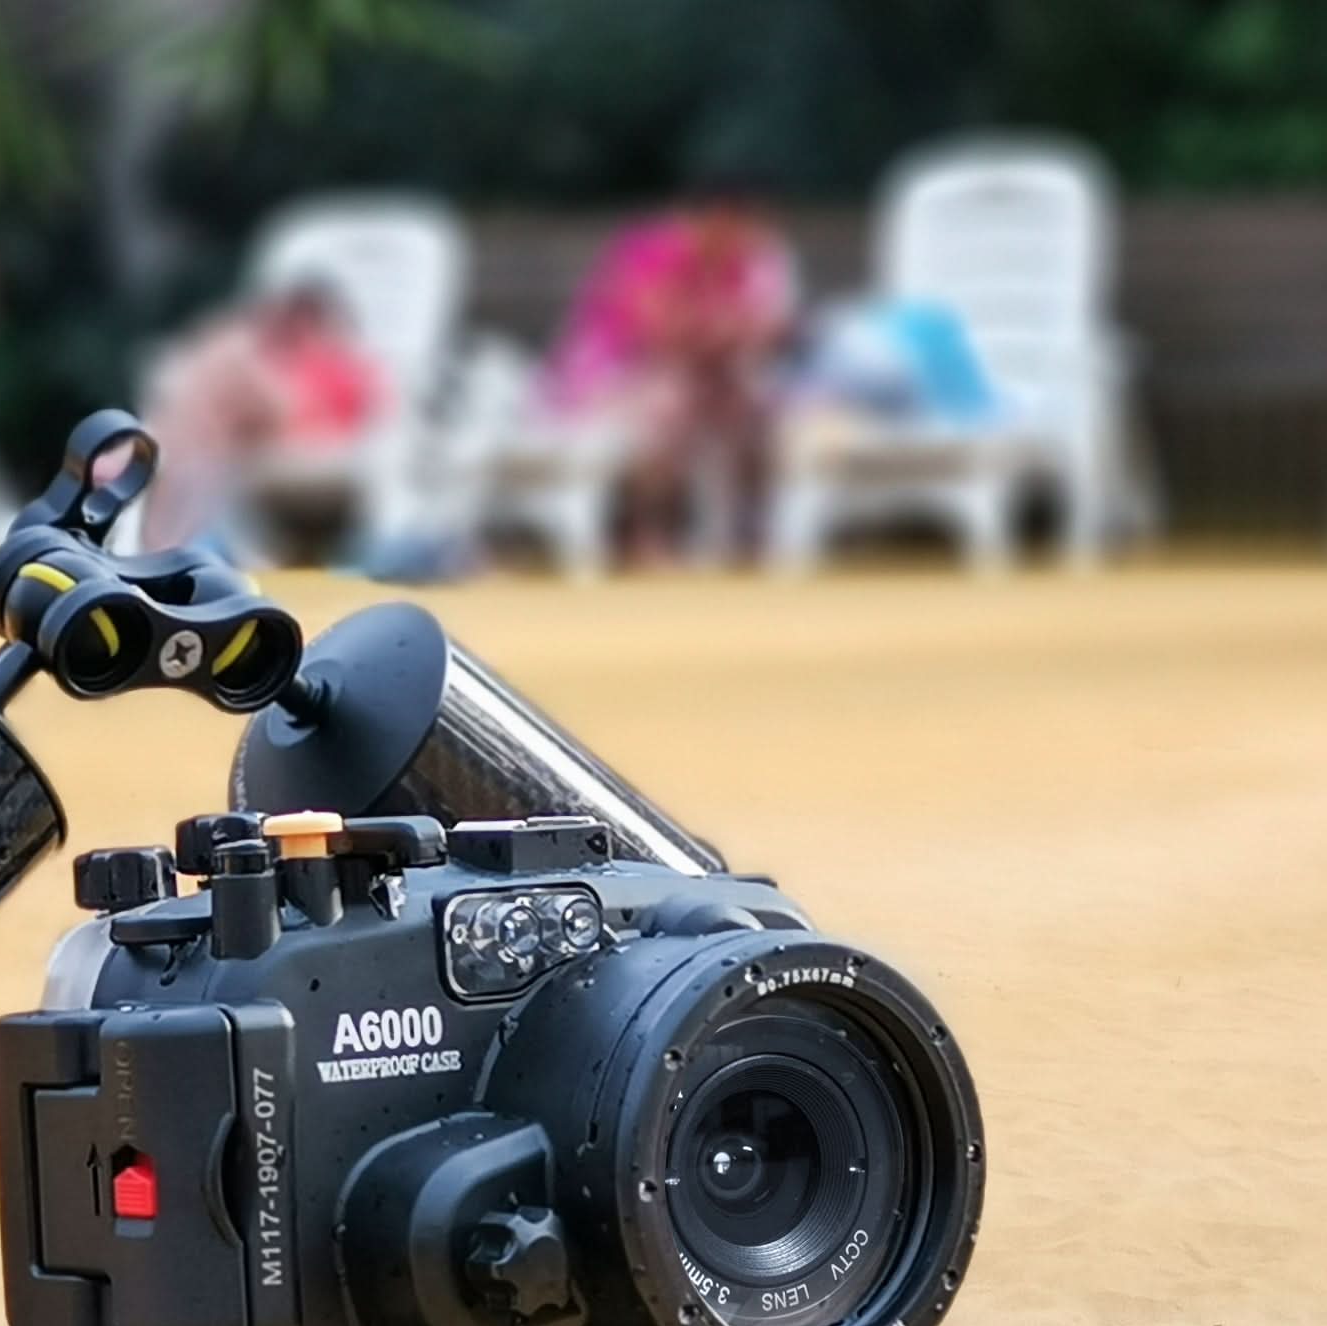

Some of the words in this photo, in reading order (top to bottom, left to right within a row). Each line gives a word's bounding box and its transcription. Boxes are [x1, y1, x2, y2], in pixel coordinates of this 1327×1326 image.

[333, 1006, 443, 1053] A6000
[317, 1055, 420, 1083] WATERPROOF
[420, 1050, 462, 1073] CASE
[254, 1067, 283, 1286] M117-1907-077
[830, 1229, 869, 1281] CCTV
[761, 1283, 810, 1312] LENS
